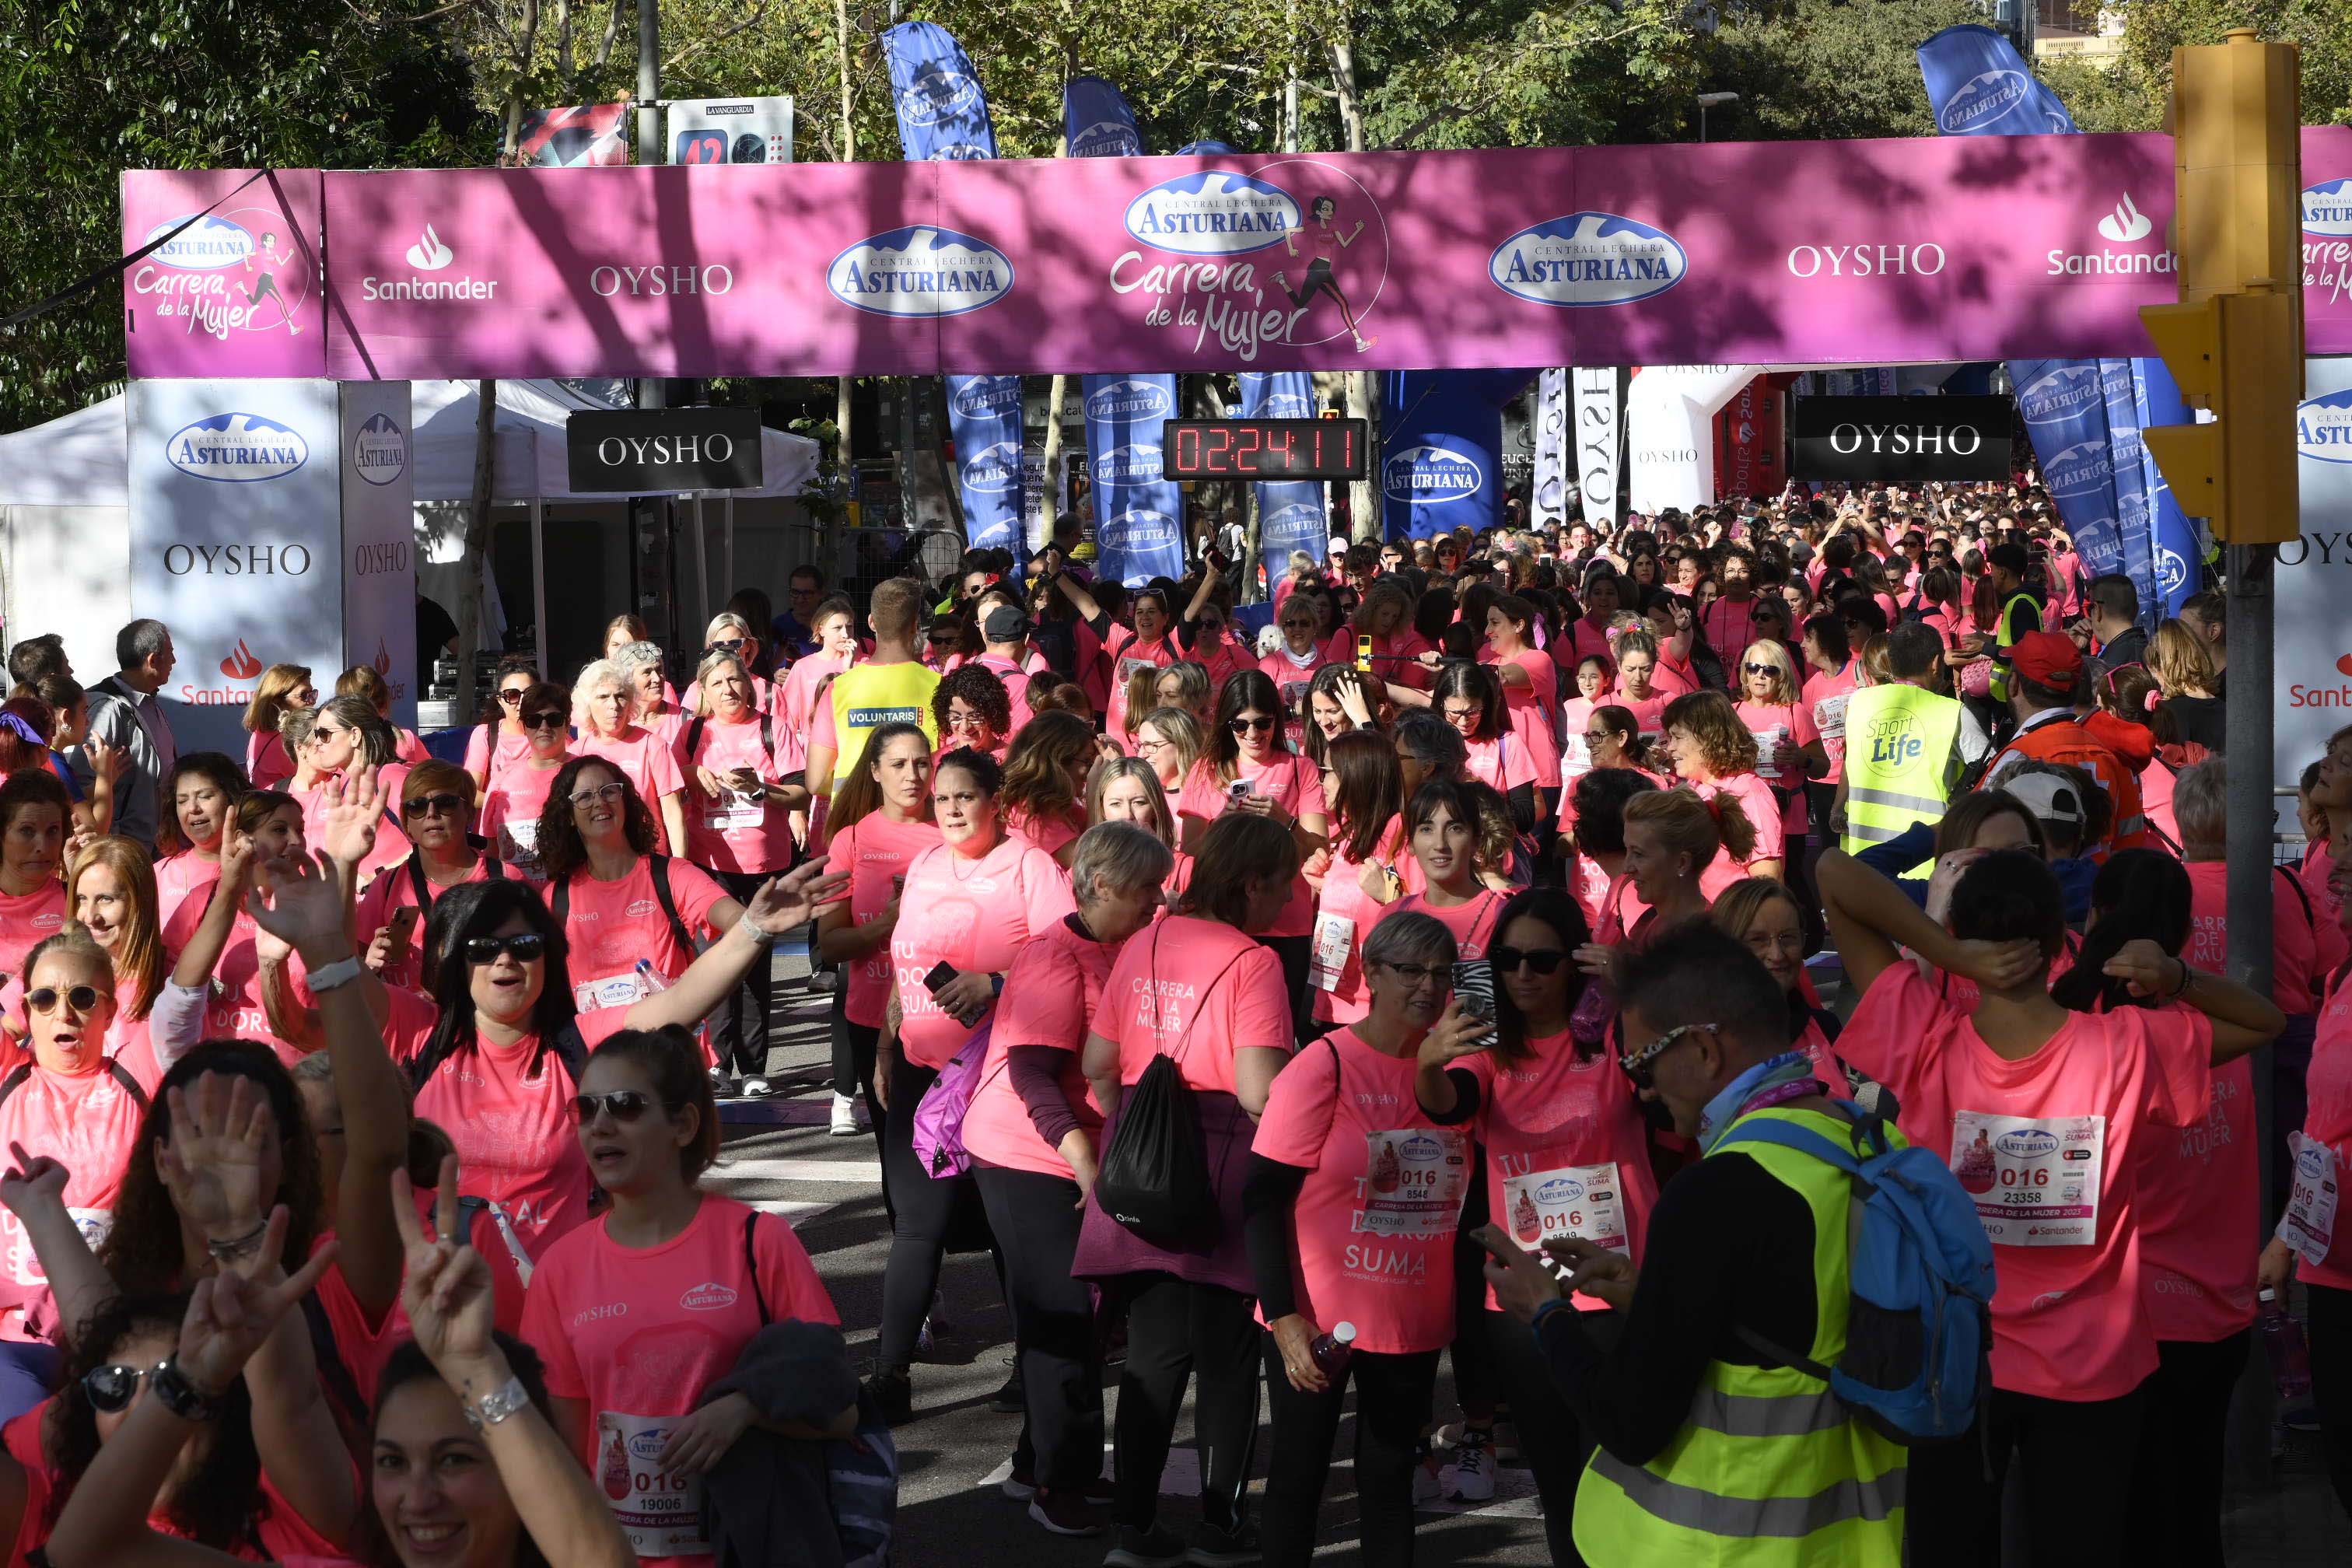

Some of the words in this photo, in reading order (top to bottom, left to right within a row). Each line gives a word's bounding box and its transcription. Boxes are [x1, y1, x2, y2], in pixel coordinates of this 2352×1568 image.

[1165, 199, 1219, 208] CENTRAL
[1226, 198, 1283, 208] LECHERA
[1138, 203, 1286, 234] ASTURIANA
[1535, 245, 1596, 256] CENTRAL
[1602, 243, 1665, 254] LECHERA
[870, 256, 926, 267] CENTRAL
[934, 256, 994, 266] LECHERA
[1504, 248, 1672, 283] ASTURIANA
[1788, 243, 1944, 277] OYSHO
[2048, 249, 2177, 275] Santand
[135, 266, 226, 295] Carrera
[590, 264, 733, 297] OYSHO
[842, 261, 1000, 294] ASTURIANA
[1110, 251, 1255, 294] Carrera
[2319, 264, 2333, 286] la
[362, 275, 498, 301] Santander
[156, 296, 173, 317] de
[177, 297, 189, 317] la
[187, 292, 261, 341] Mujer
[1145, 297, 1171, 327] de
[1178, 296, 1197, 326] la
[1193, 289, 1309, 362] Mujer
[1041, 405, 1082, 417] b.cat
[248, 436, 293, 445] LECHERA
[1830, 423, 1981, 455] OYSHO
[177, 438, 298, 465] ASTURIANA
[358, 440, 402, 467] ASTURIANA
[598, 433, 733, 466] OYSHO
[1177, 429, 1350, 471] 02:24:11
[1640, 449, 1698, 464] OYSHO
[1387, 470, 1474, 491] ASTURIANA
[164, 544, 311, 576] OYSHO
[355, 541, 406, 576] OYSHO
[849, 712, 915, 723] VOLUNTARIS
[1867, 716, 1914, 739] Sport
[1871, 733, 1921, 766] Life
[1580, 863, 1605, 877] DO
[572, 912, 598, 923] YSHO
[1320, 943, 1334, 955] 016
[2196, 932, 2218, 946] DE
[894, 941, 915, 959] TU
[866, 961, 895, 978] SU
[899, 967, 933, 986] DO
[602, 987, 636, 1002] ASTURIANA
[1132, 978, 1195, 999] CARRERA
[1164, 998, 1178, 1015] LA
[1136, 1011, 1181, 1033] MUJER
[443, 1064, 485, 1087] OSHO
[2207, 1105, 2226, 1128] LA
[2001, 1139, 2054, 1153] ASTURIANA
[2065, 1133, 2091, 1142] SUMA
[2179, 1125, 2231, 1160] MUJER
[1499, 1151, 1531, 1178] TU
[1402, 1170, 1437, 1185] 016
[2000, 1168, 2049, 1187] 016
[1406, 1189, 1429, 1199] 8548
[1538, 1188, 1581, 1202] ASTURIANA
[2004, 1192, 2042, 1204] 23358
[2294, 1181, 2314, 1206] 016
[1374, 1202, 1405, 1210] CARRERA
[2032, 1209, 2061, 1217] MUJER
[1370, 1216, 1405, 1227] OYSHO
[1544, 1210, 1583, 1230] 016
[2039, 1225, 2084, 1236] Santander
[1344, 1244, 1426, 1276] SUMA
[2154, 1279, 2204, 1299] OYSHO
[684, 1293, 734, 1307] ASTURIANA
[574, 1302, 628, 1326] OYSHO
[635, 1472, 686, 1493] 016
[640, 1498, 681, 1510] 19006
[644, 1515, 656, 1524] DE
[658, 1516, 669, 1525] LA
